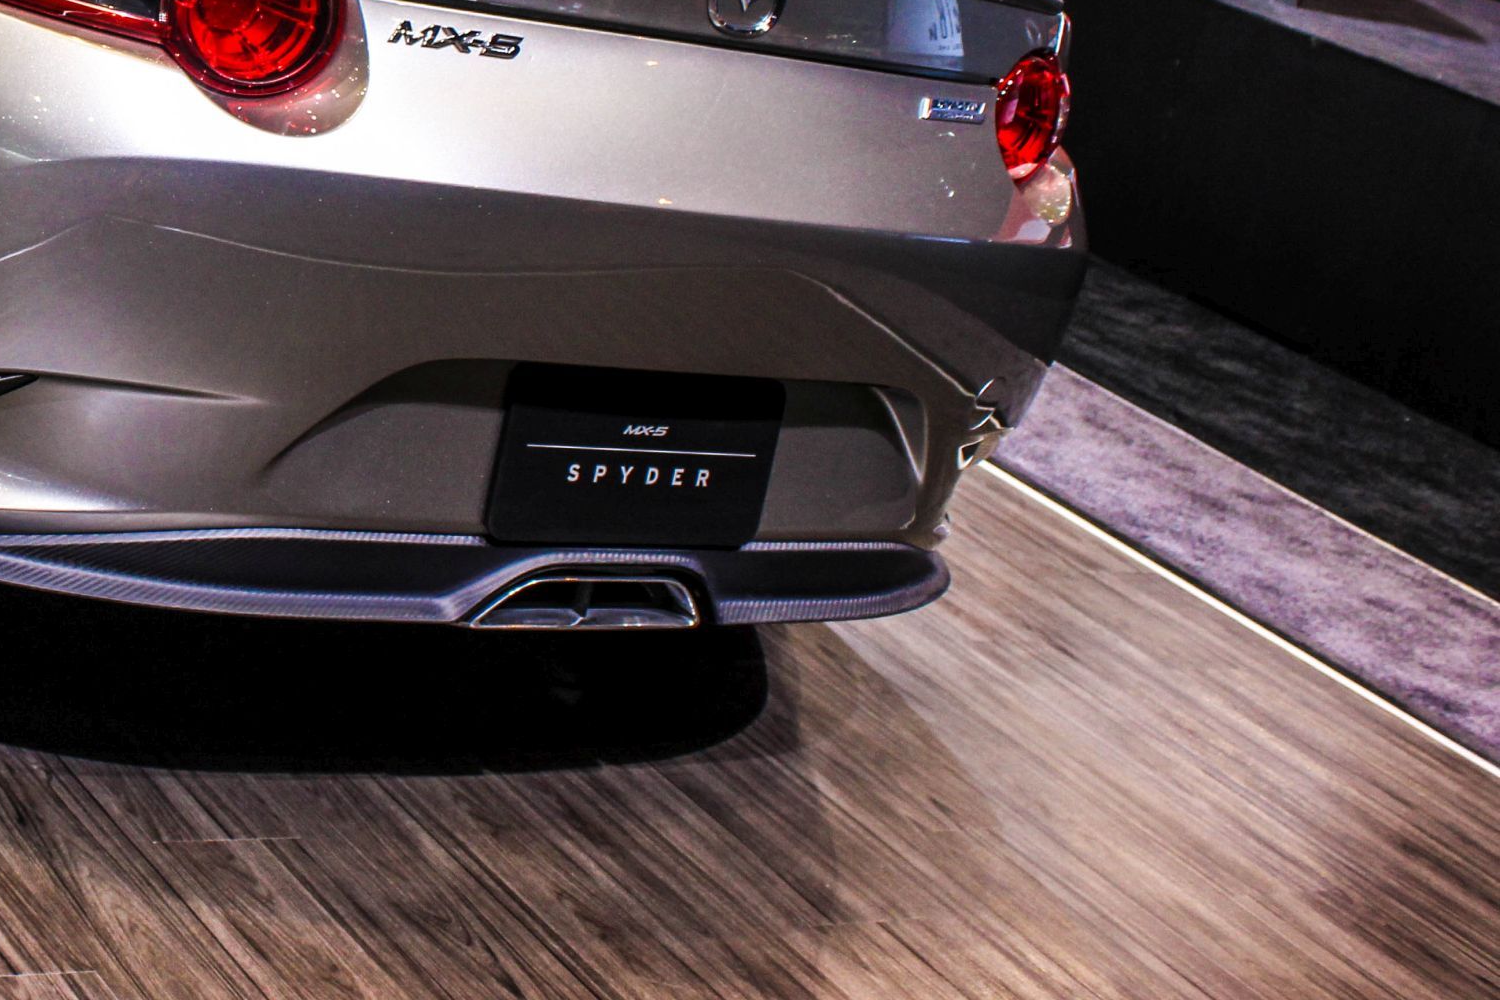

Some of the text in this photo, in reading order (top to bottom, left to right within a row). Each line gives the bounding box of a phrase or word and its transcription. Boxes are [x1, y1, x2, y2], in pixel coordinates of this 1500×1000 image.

[387, 20, 525, 60] MX-5
[622, 424, 670, 437] MX-5
[566, 463, 711, 488] SPYDER
